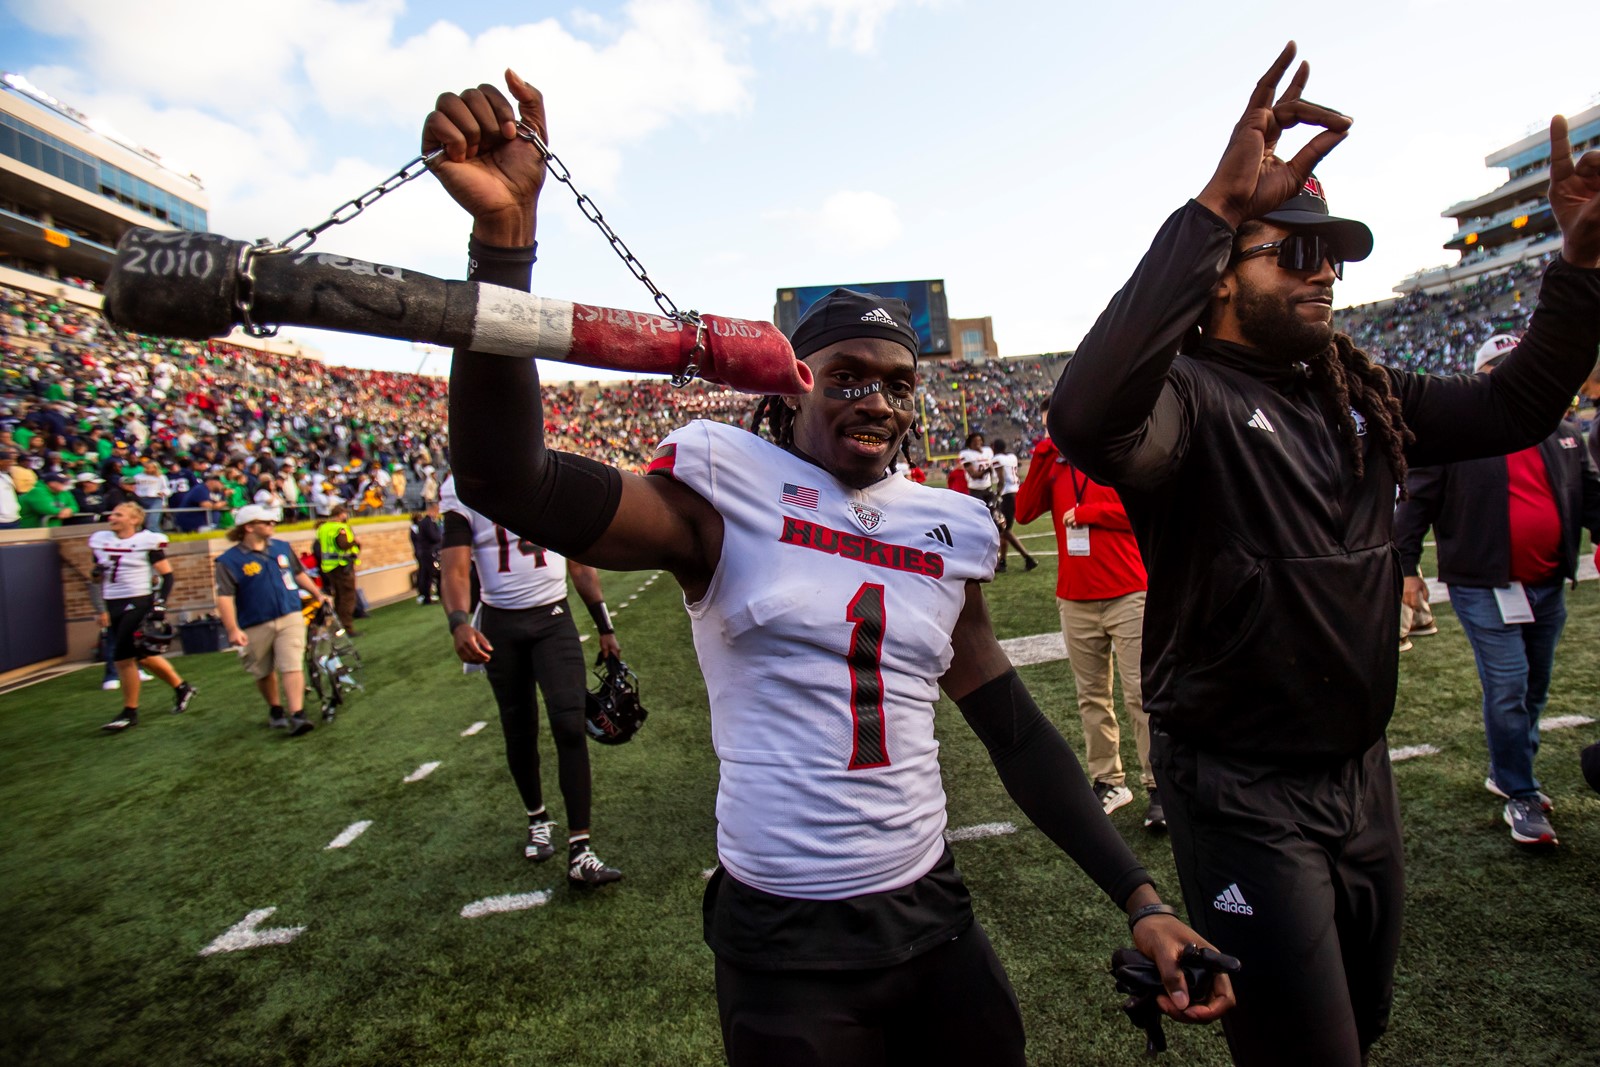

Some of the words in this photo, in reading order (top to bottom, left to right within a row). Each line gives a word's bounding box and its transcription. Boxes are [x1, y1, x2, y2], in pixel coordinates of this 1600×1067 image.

[123, 246, 214, 279] 2010
[861, 315, 899, 328] adidas
[842, 382, 880, 399] JOHN
[779, 515, 944, 579] HUSKIES
[846, 582, 891, 770] 1
[1213, 900, 1254, 916] adidas
